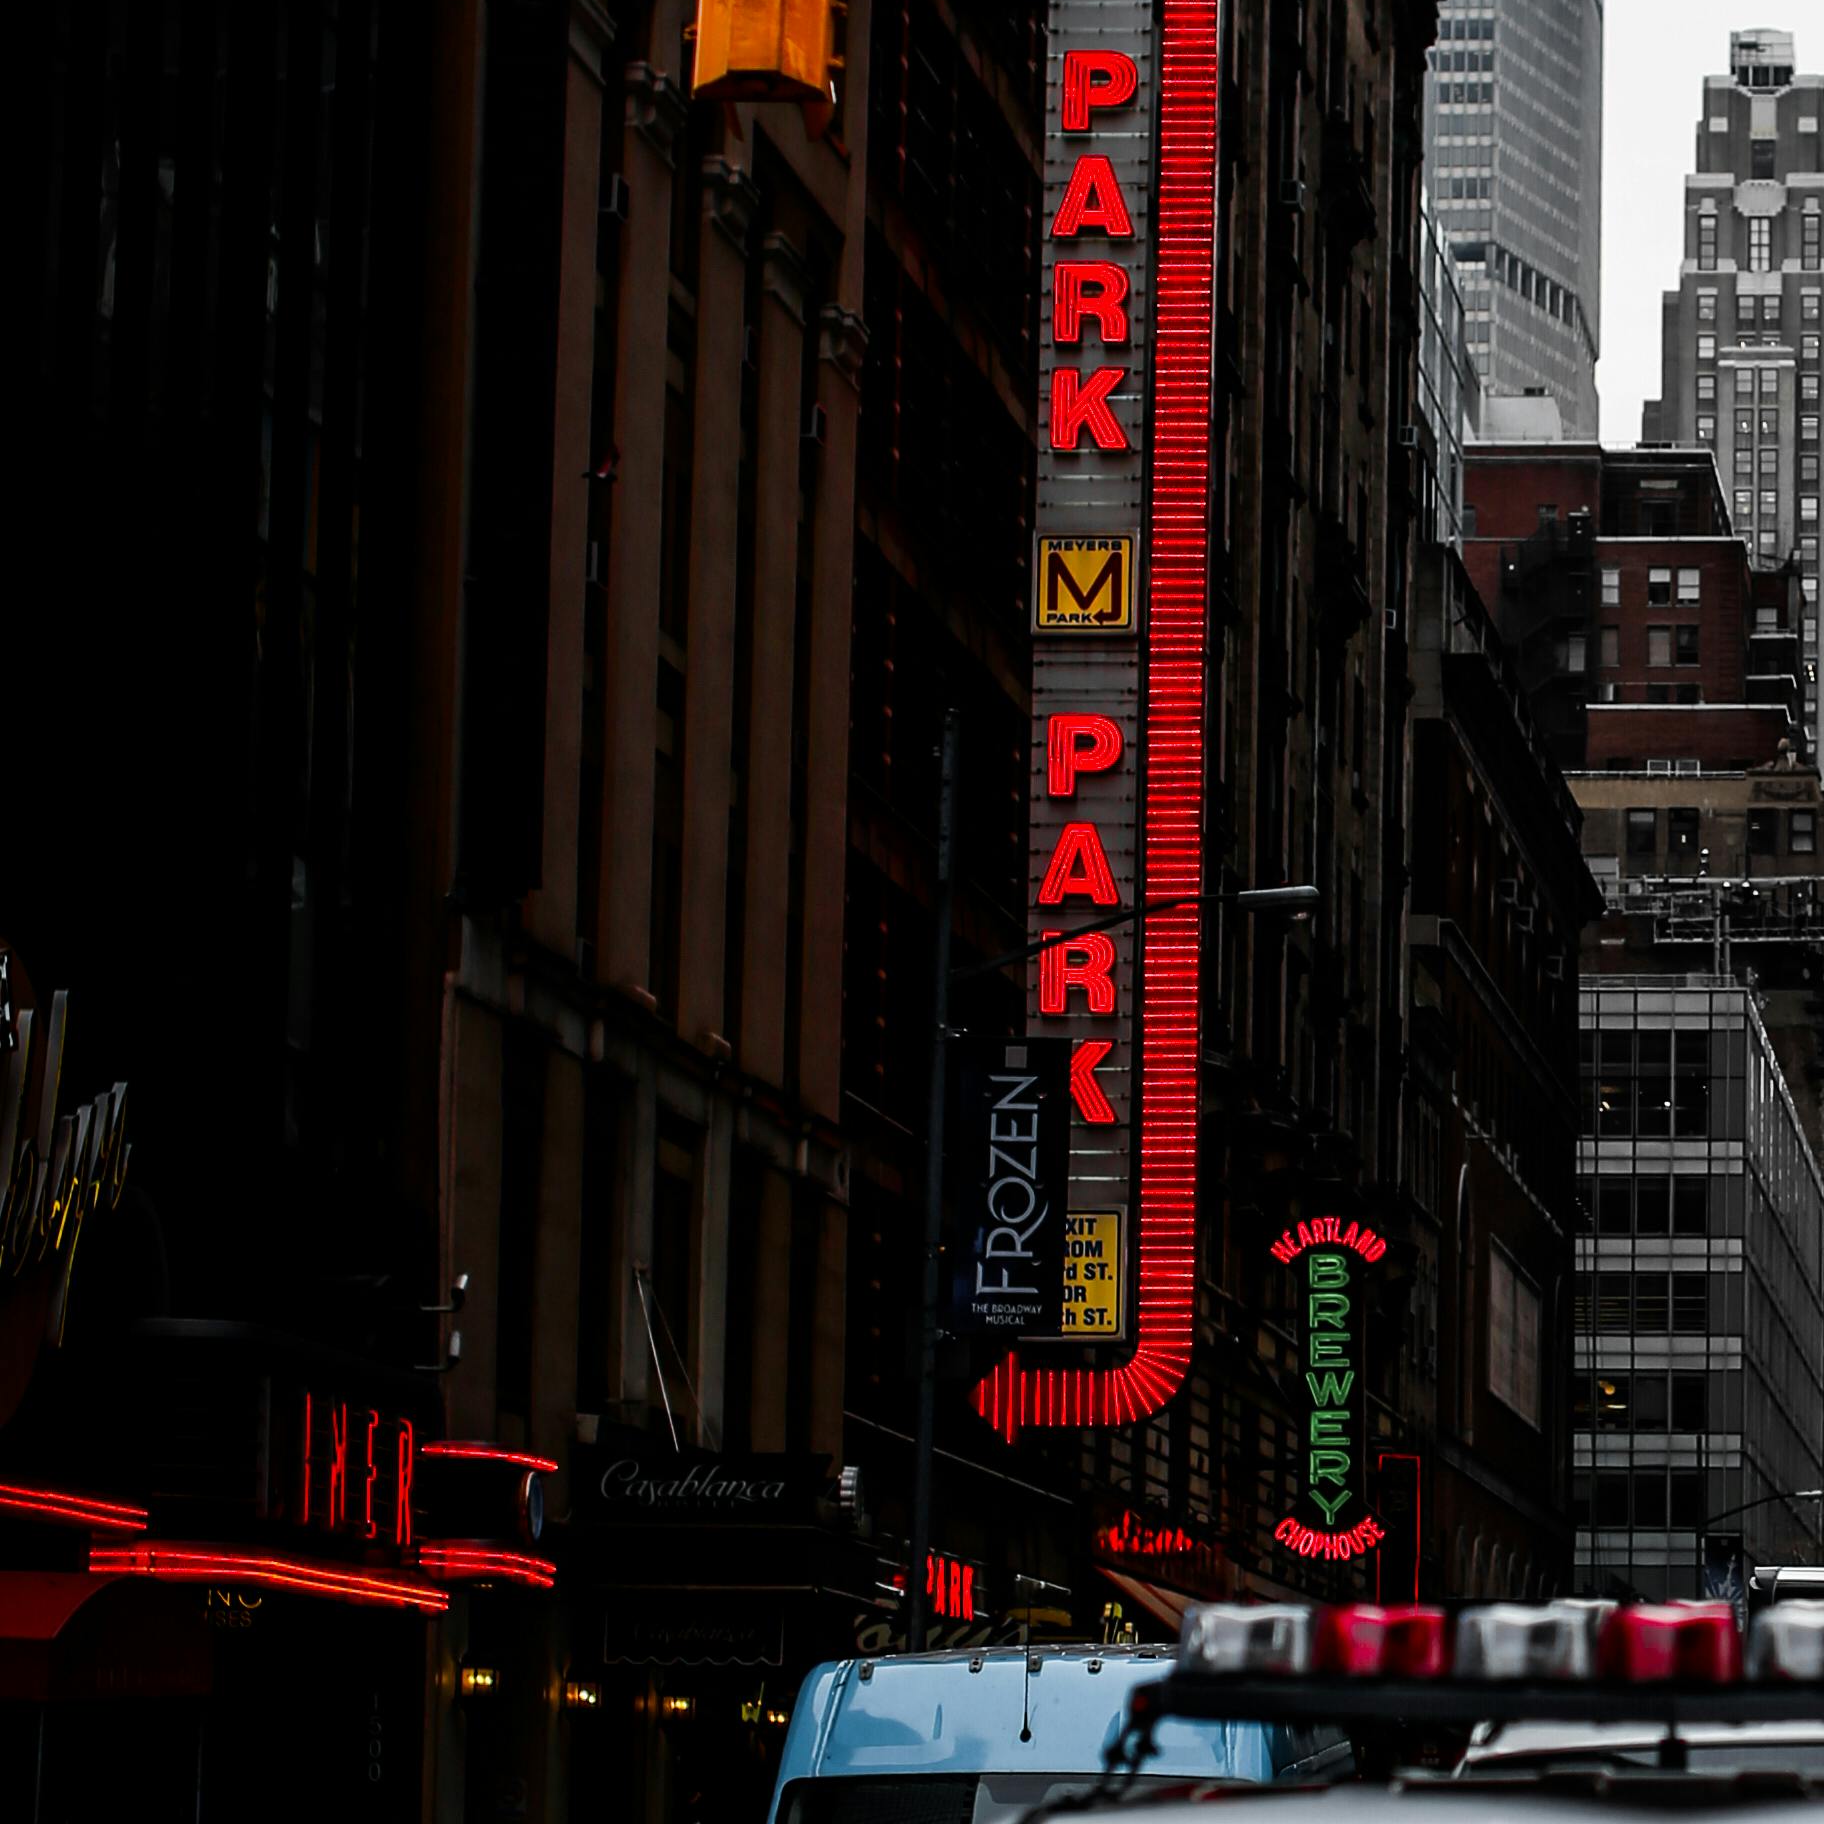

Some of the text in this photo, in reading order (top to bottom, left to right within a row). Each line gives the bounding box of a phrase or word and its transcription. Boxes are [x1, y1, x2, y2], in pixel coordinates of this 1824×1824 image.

[1050, 50, 1138, 451] PARK
[1048, 541, 1122, 551] MEYERS
[1047, 613, 1092, 623] PARK
[974, 1074, 1049, 1296] FROZEN
[1065, 1218, 1097, 1235] XIT
[1270, 1216, 1387, 1265] HEARTLAND
[1065, 1240, 1103, 1258] OM
[971, 1302, 1043, 1314] THE BROADWAY
[985, 1315, 1025, 1326] MUSICAL
[1305, 1253, 1355, 1525] BREWERY
[600, 1458, 787, 1507] Casablanca
[1274, 1514, 1386, 1561] CHOPHOUSE
